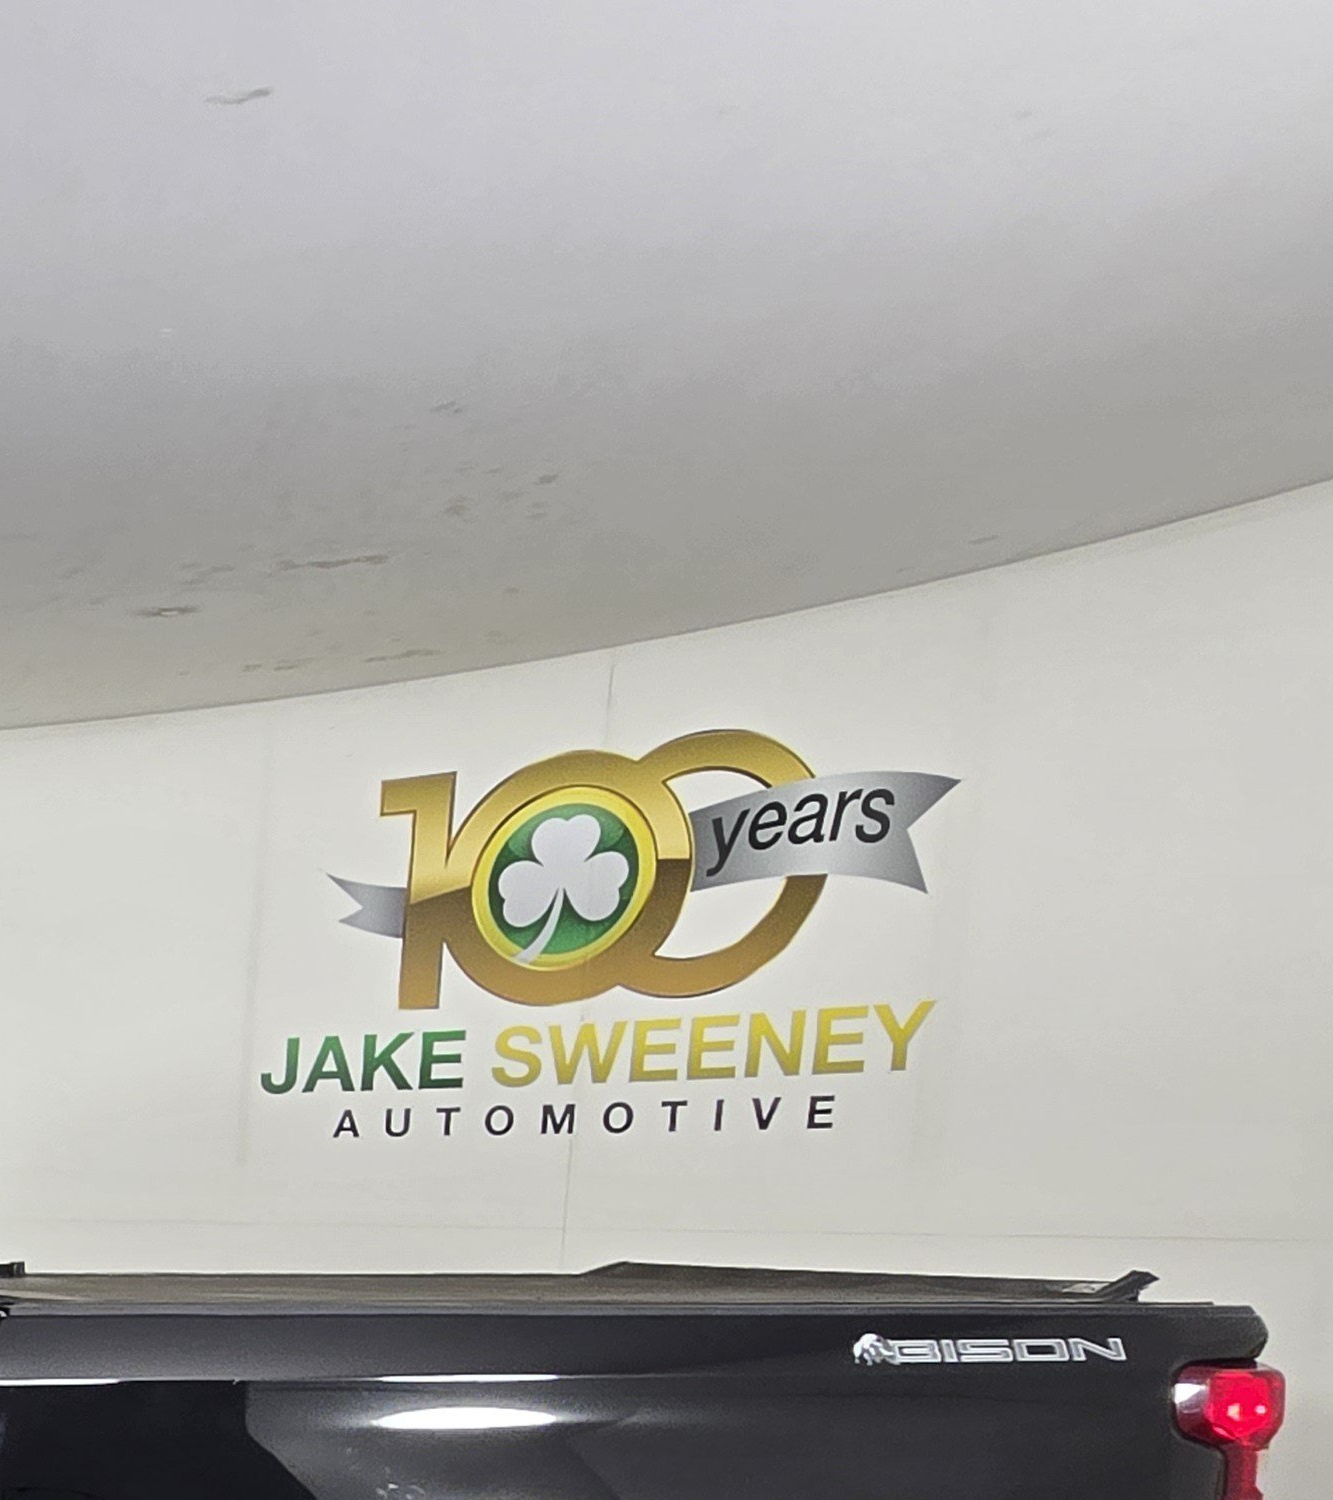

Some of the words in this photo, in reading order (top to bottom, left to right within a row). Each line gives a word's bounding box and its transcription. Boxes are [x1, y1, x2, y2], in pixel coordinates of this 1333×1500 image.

[706, 783, 896, 877] years
[260, 1029, 467, 1095] JAKE
[491, 999, 937, 1087] SWEENEY
[333, 1094, 836, 1139] AUTOMOTIVE
[891, 1337, 1128, 1363] BISON
